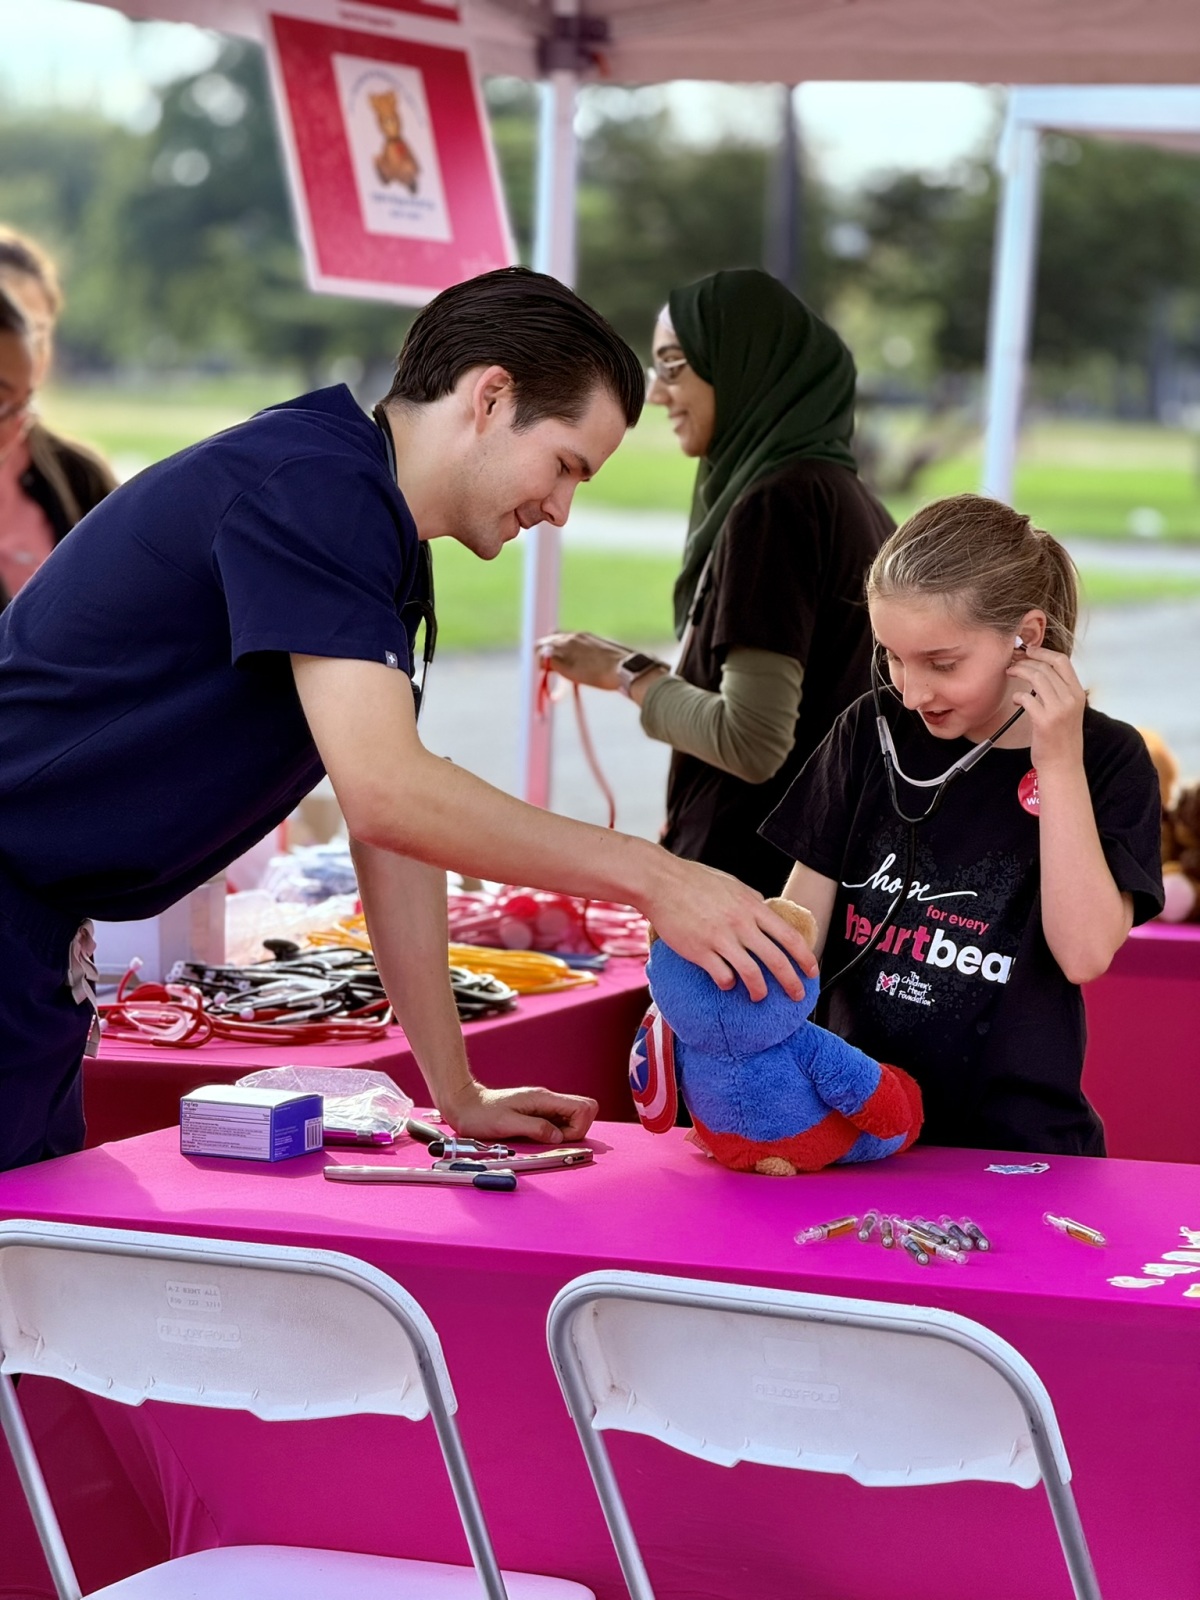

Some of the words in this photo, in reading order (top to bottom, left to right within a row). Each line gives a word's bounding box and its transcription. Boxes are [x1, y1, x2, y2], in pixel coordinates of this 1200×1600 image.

[842, 853, 978, 901] hope
[926, 904, 948, 922] for
[949, 914, 989, 936] every
[845, 903, 1016, 985] heartbea
[901, 976, 933, 991] Children's
[907, 985, 928, 997] Heart
[897, 990, 932, 1006] Foundation
